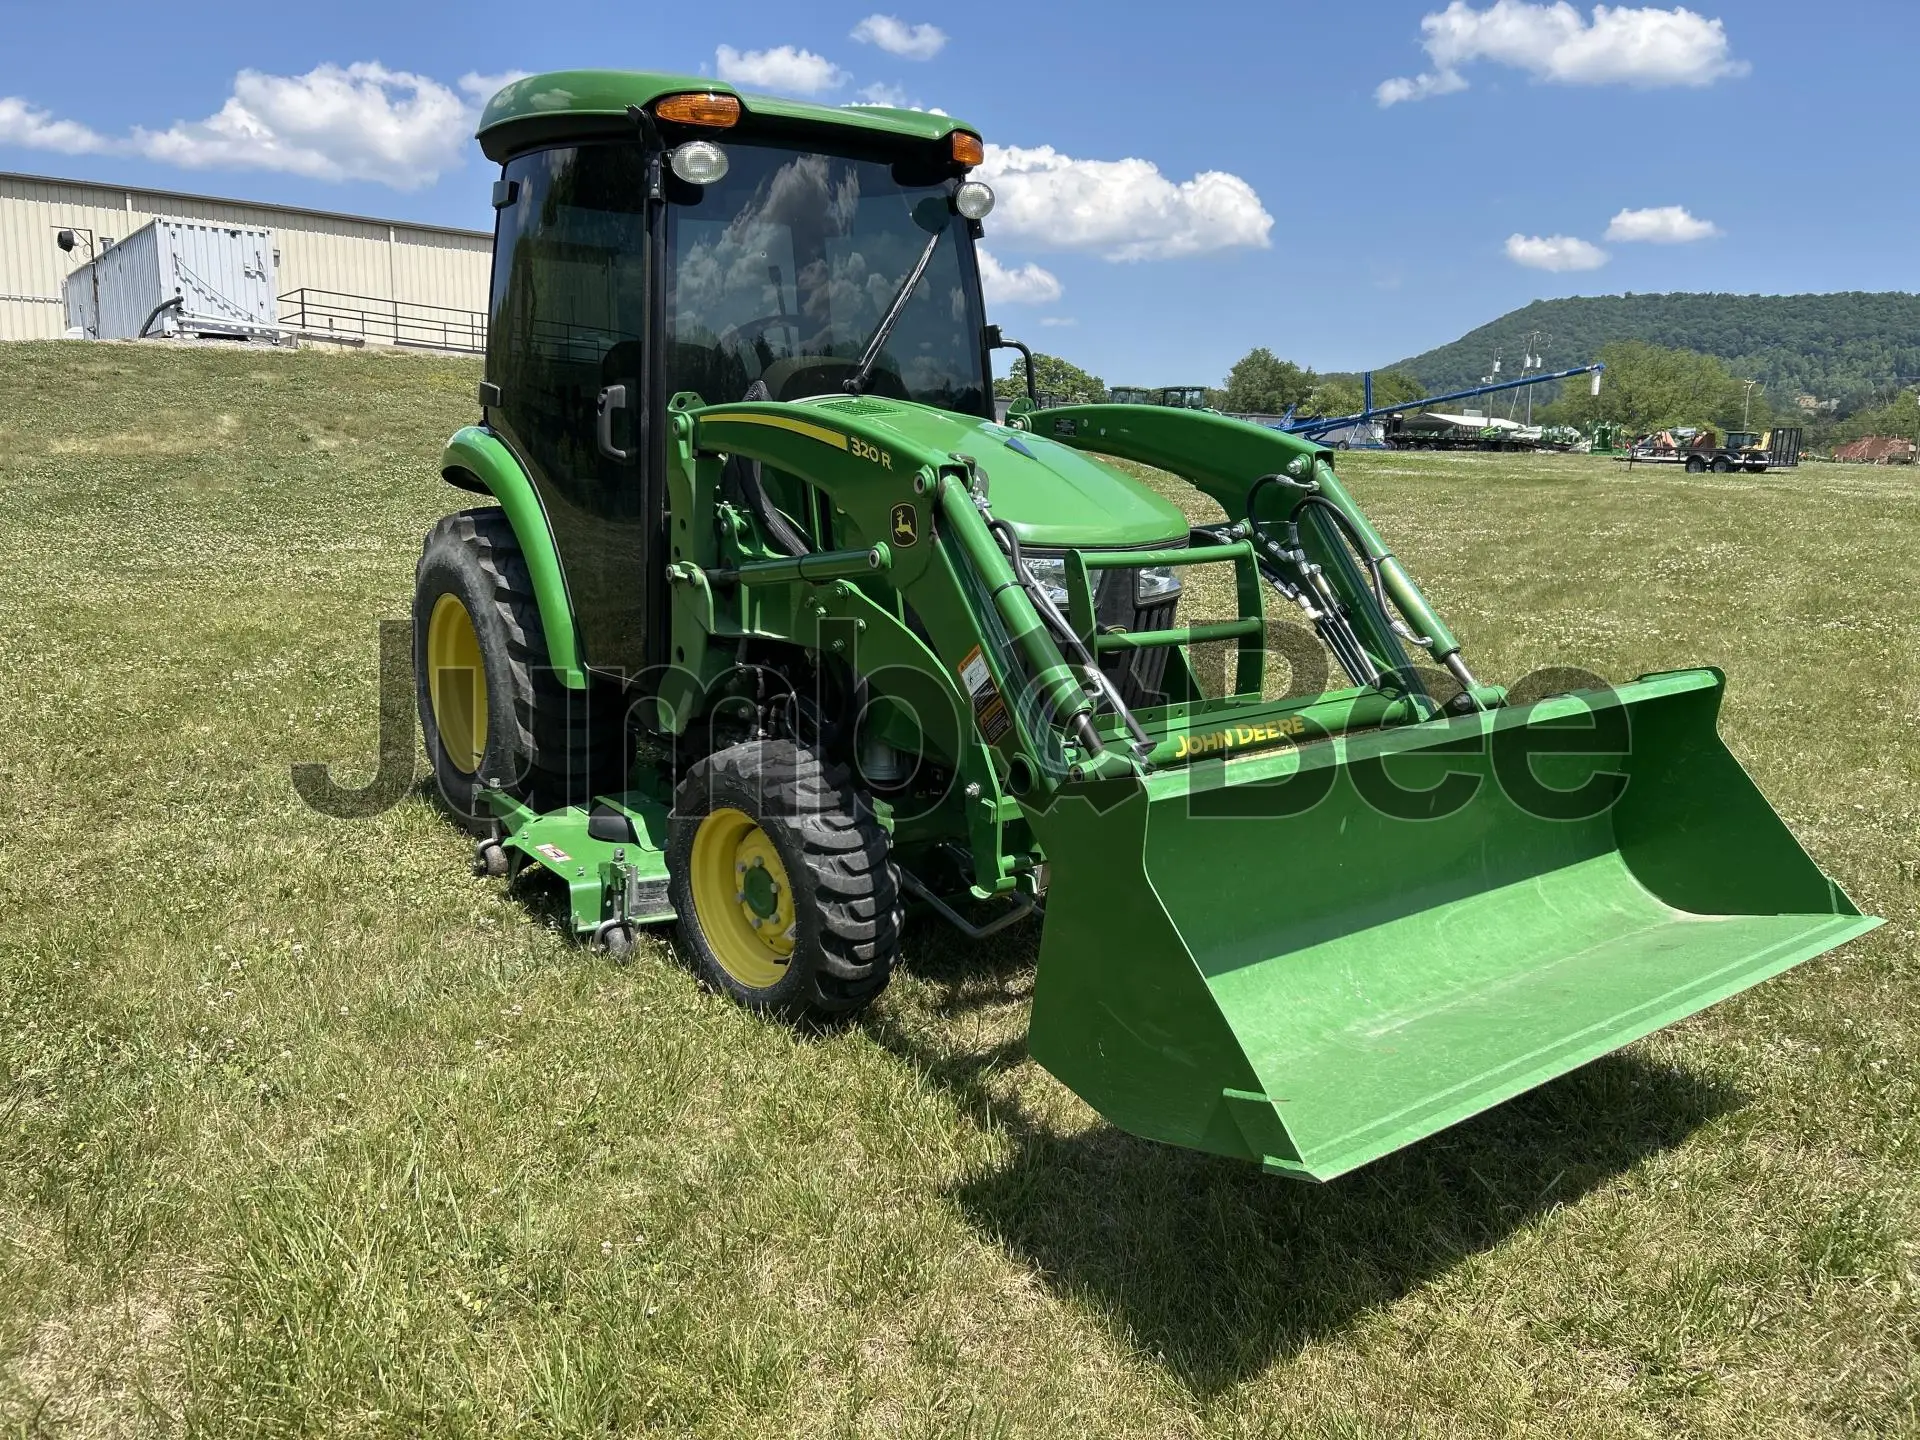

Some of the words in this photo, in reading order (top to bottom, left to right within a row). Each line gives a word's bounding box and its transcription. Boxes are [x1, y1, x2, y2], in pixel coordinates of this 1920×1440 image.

[851, 437, 878, 462] 320
[1175, 728, 1233, 758] JOHN
[1235, 716, 1305, 744] DEERE
